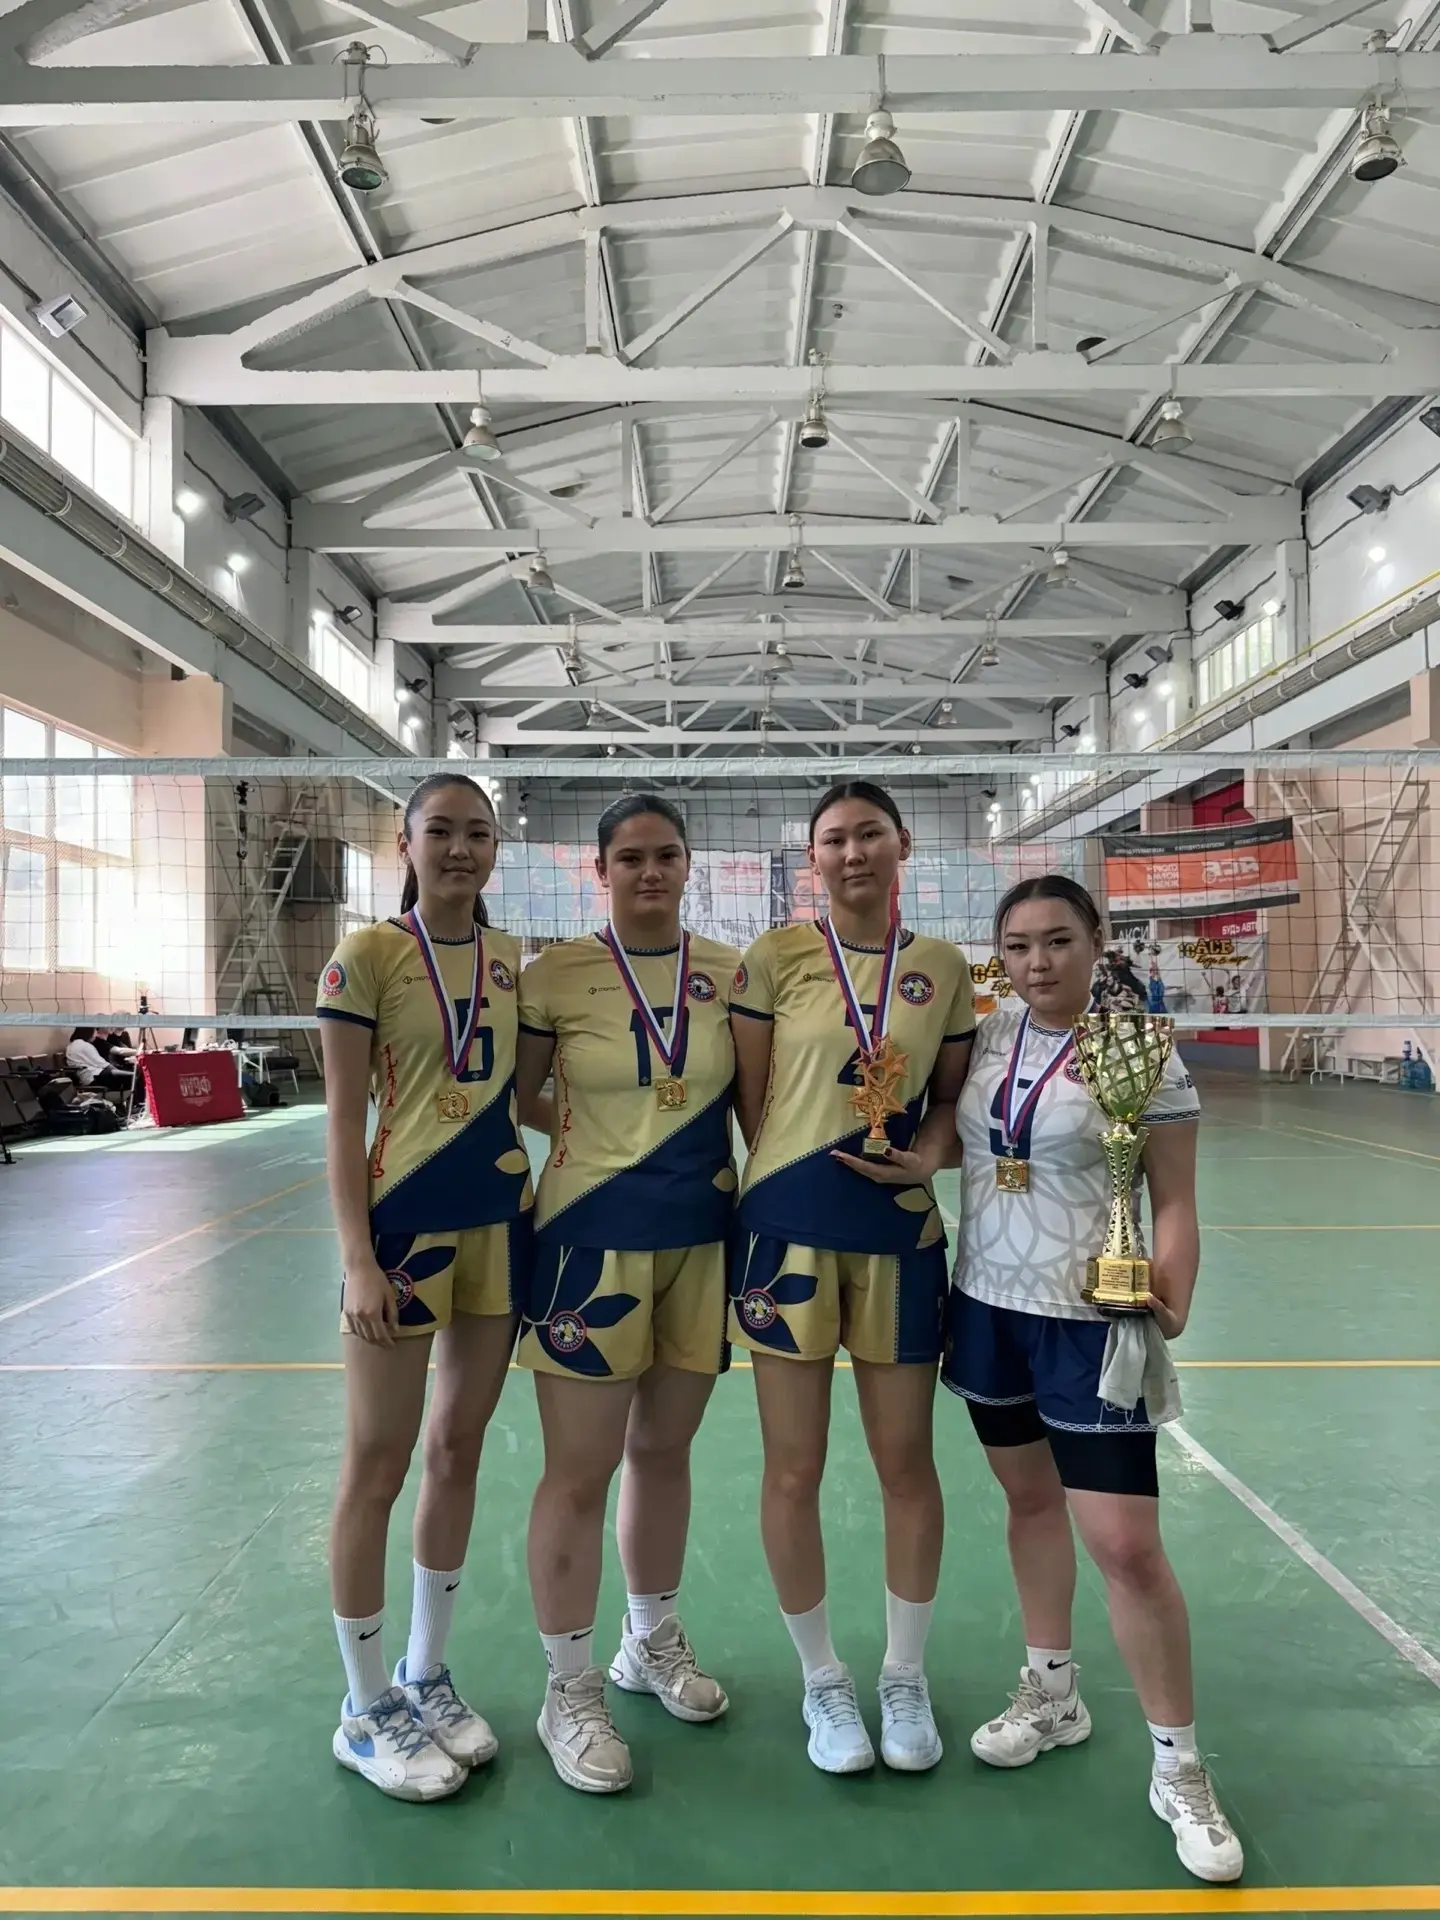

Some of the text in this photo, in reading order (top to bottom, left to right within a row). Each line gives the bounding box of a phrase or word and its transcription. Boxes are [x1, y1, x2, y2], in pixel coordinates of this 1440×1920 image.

[1241, 921, 1257, 932] АВТ
[454, 997, 495, 1083] 6
[629, 1006, 690, 1087] 17
